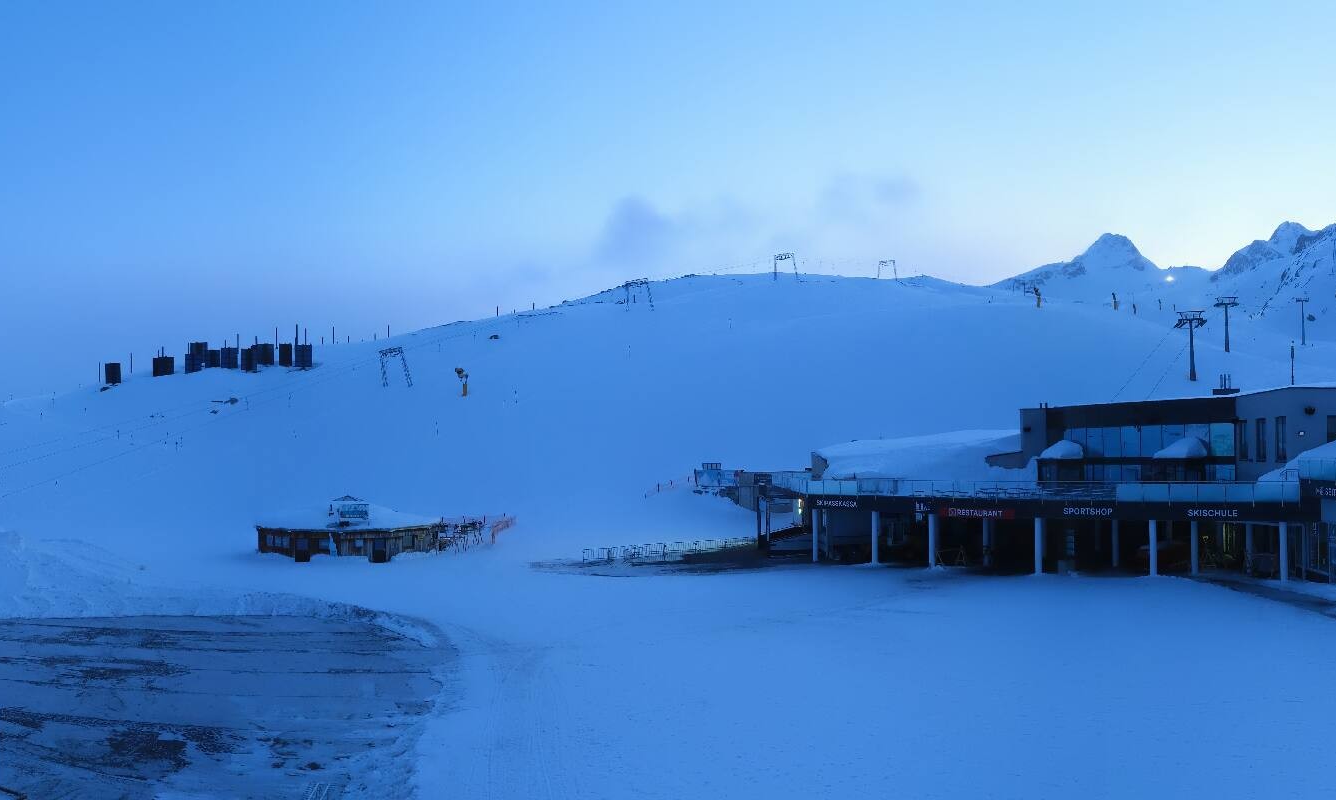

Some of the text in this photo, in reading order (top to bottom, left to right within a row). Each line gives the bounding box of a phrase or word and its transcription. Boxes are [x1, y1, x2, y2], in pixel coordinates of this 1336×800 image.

[957, 508, 1003, 517] RESTAURANT
[1063, 507, 1113, 516] SPORTSHOP
[1187, 509, 1238, 517] SKISCHULE
